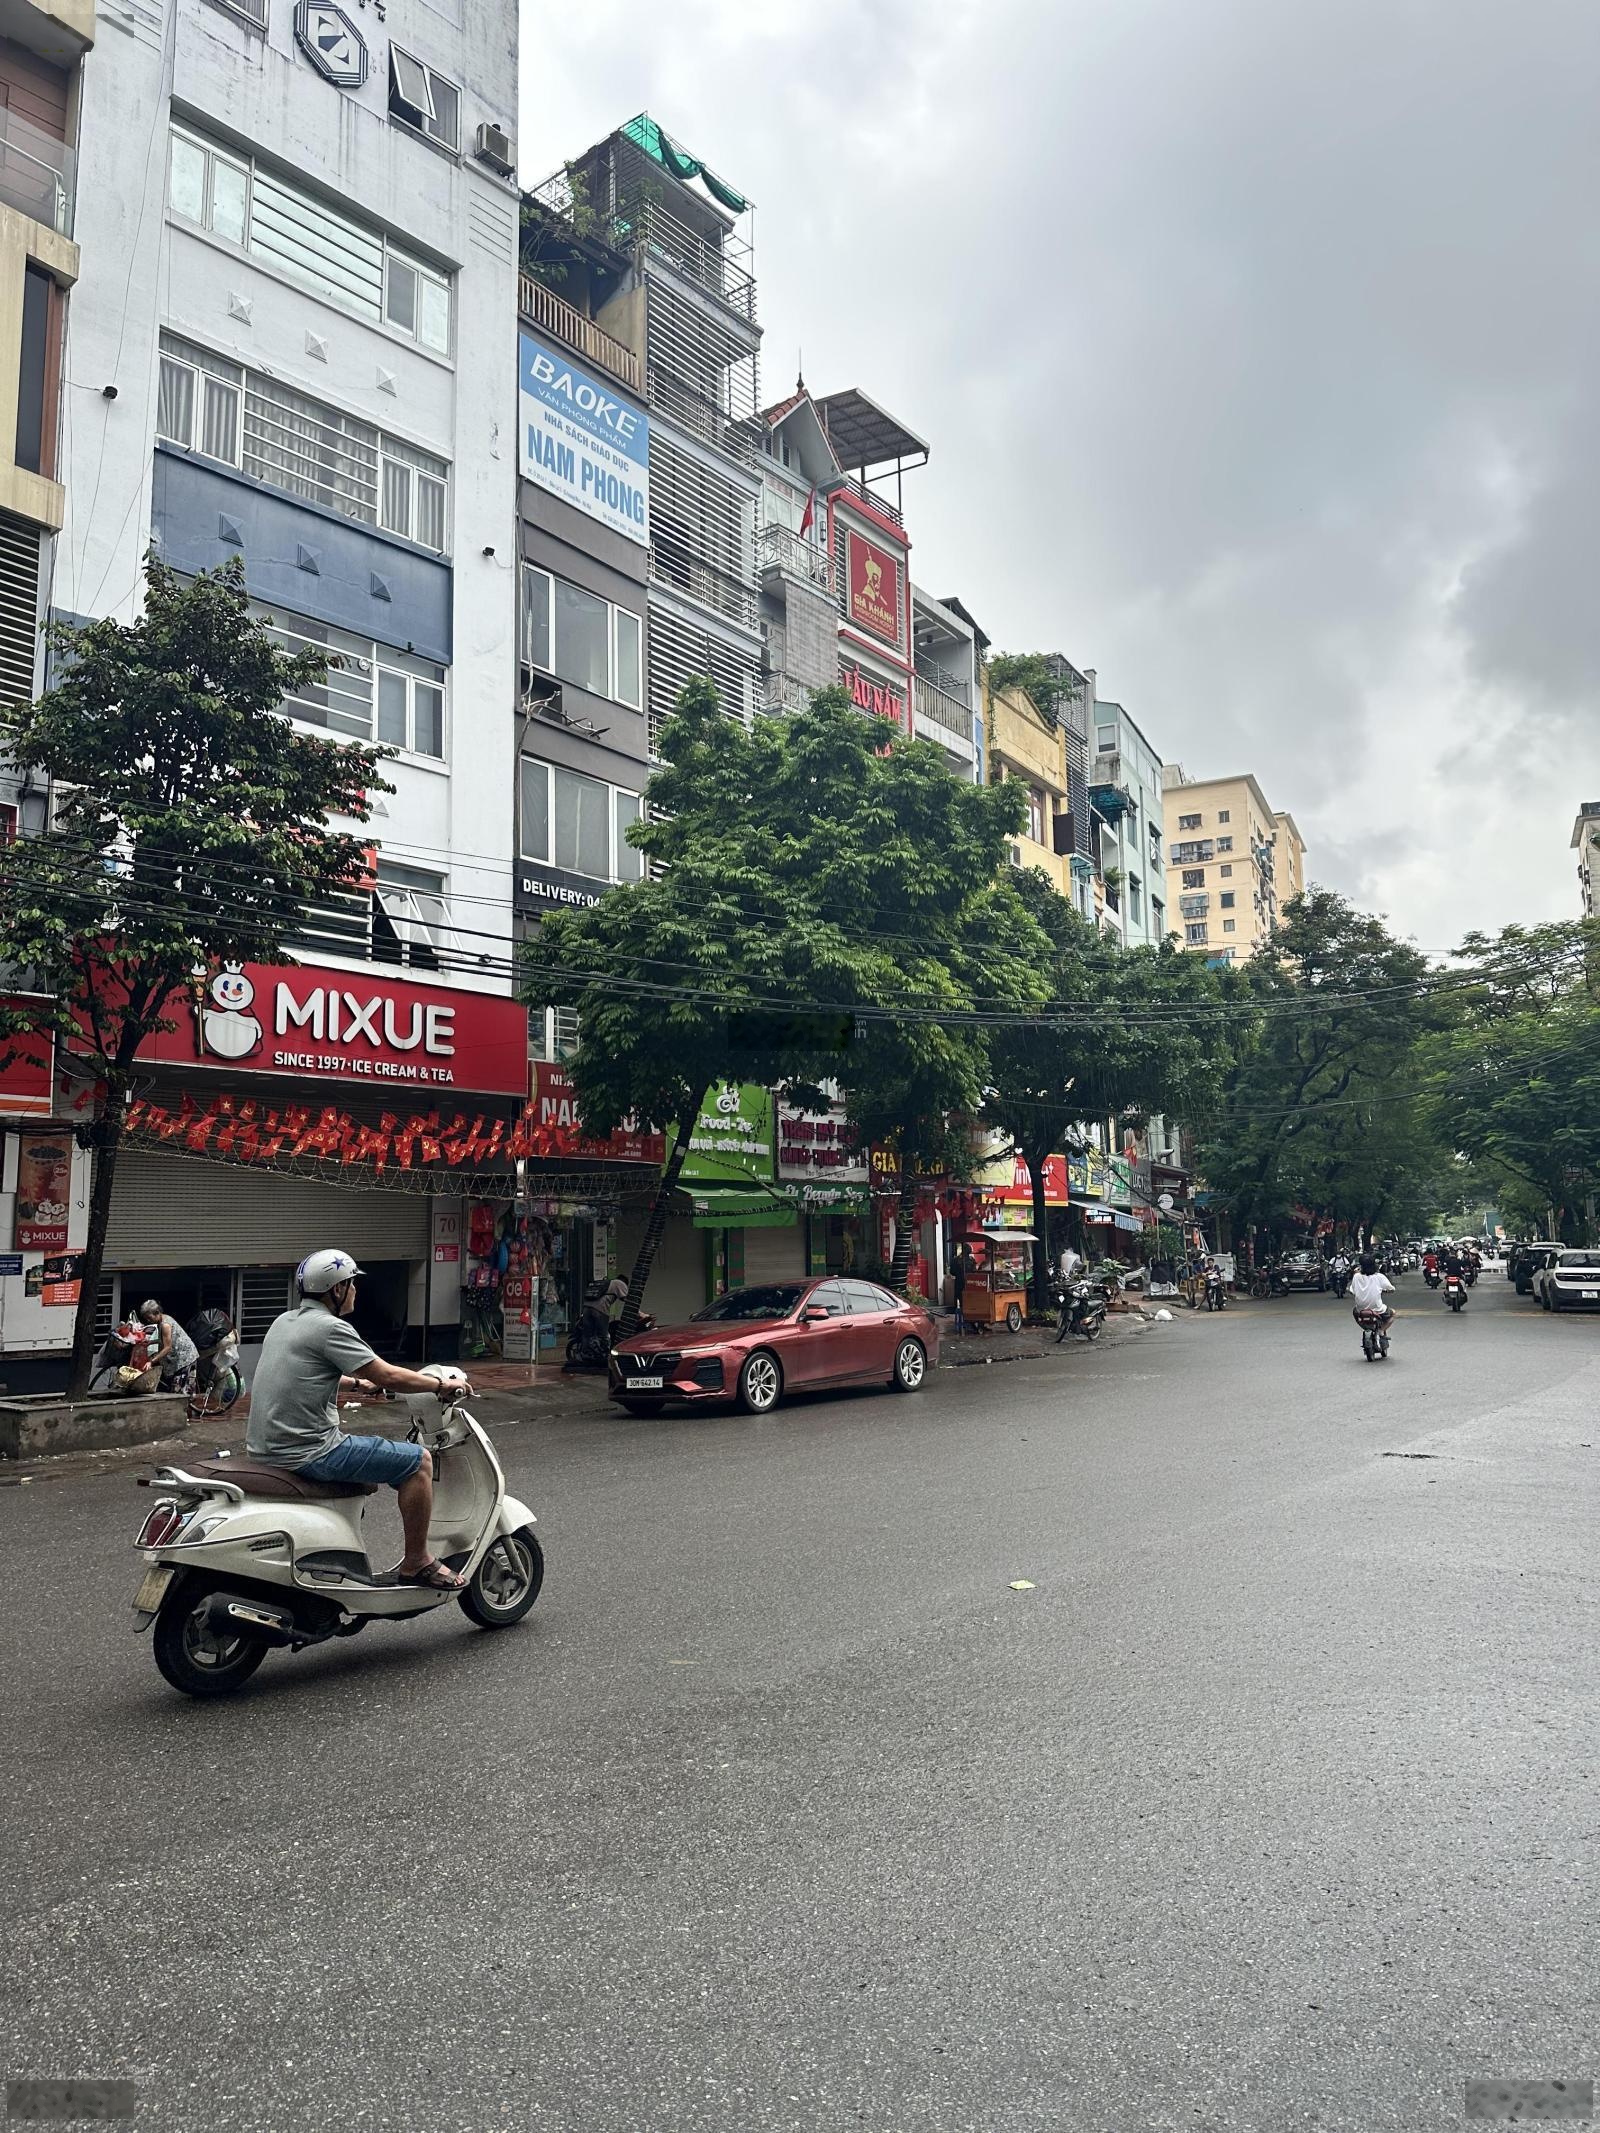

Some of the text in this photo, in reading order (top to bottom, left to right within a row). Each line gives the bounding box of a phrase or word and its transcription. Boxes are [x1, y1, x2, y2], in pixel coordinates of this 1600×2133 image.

[530, 353, 638, 440] BAOKE
[565, 425, 589, 447] SÁCH
[528, 424, 575, 485] NAM
[581, 456, 645, 526] PHONG
[523, 878, 585, 906] DELIVERY:
[276, 982, 455, 1055] MIXUE
[274, 1051, 314, 1068] SINCE
[374, 1061, 416, 1078] CREAM
[420, 1066, 429, 1079] &
[431, 1068, 454, 1082] TEA
[872, 1151, 897, 1173] GIA
[33, 1231, 65, 1241] MIXUE
[440, 1216, 456, 1233] 70
